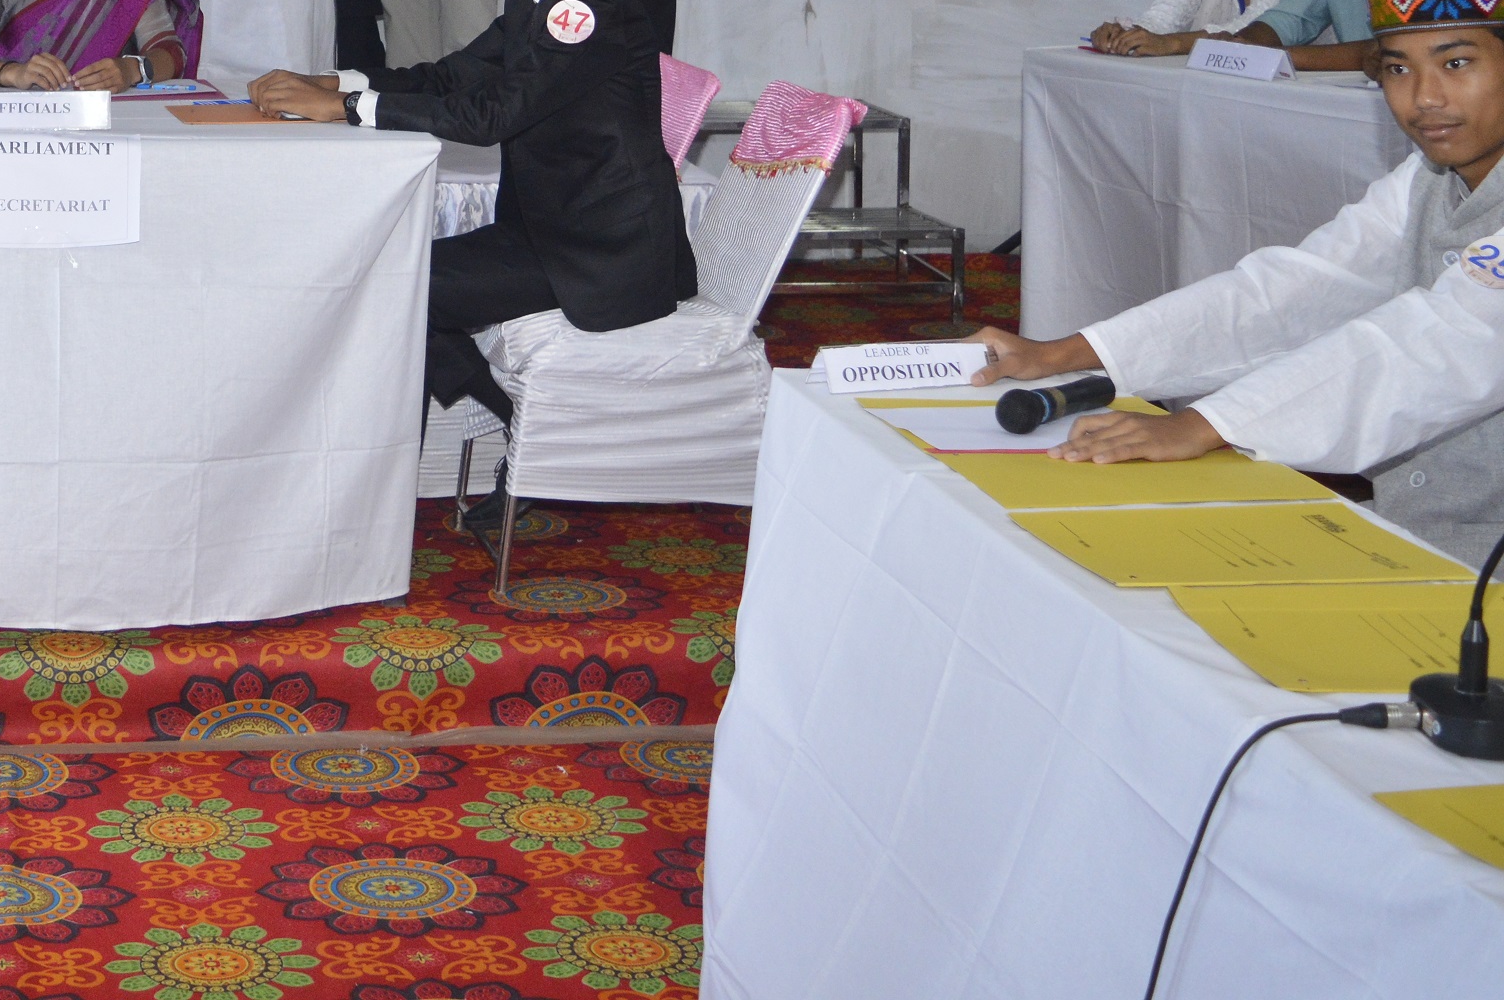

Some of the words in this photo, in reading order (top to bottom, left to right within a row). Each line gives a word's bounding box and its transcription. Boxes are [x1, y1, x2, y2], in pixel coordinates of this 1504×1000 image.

[553, 9, 590, 33] 47
[1204, 53, 1247, 71] PRESS
[864, 346, 911, 358] LEADER
[915, 345, 930, 355] OF
[842, 361, 962, 383] OPPOSITION
